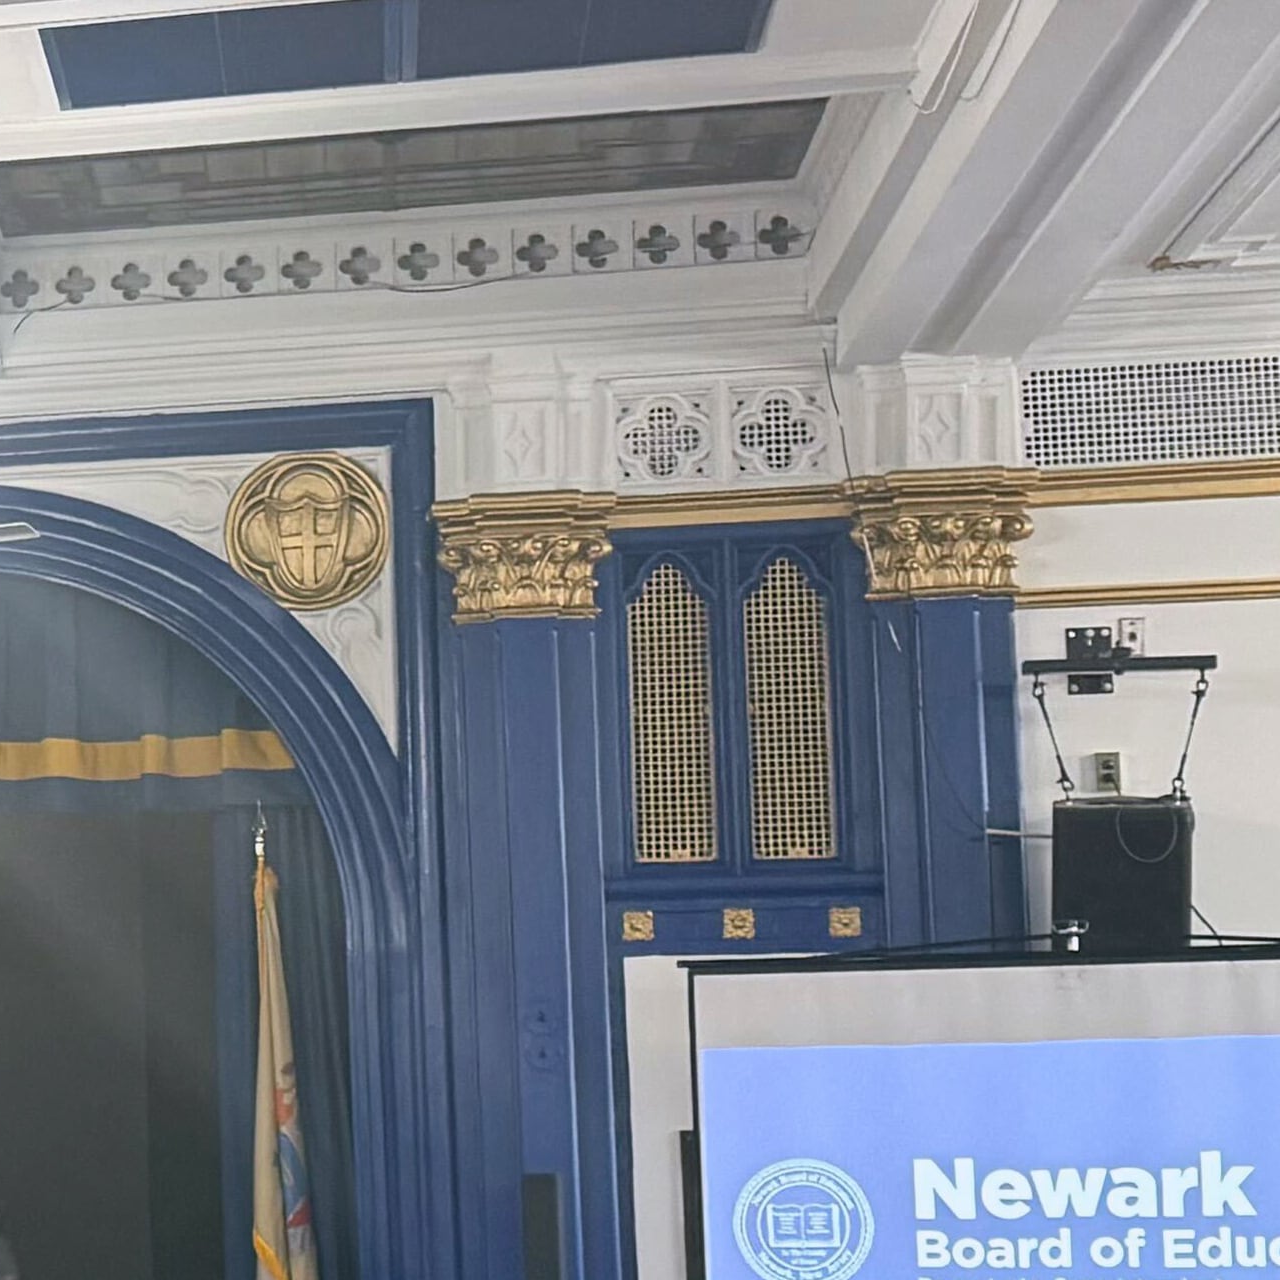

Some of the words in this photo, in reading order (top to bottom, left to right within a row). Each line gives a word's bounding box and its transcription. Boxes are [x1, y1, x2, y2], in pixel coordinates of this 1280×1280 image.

[913, 1150, 1258, 1220] Newark
[916, 1227, 1072, 1269] Board
[1089, 1227, 1146, 1268] of
